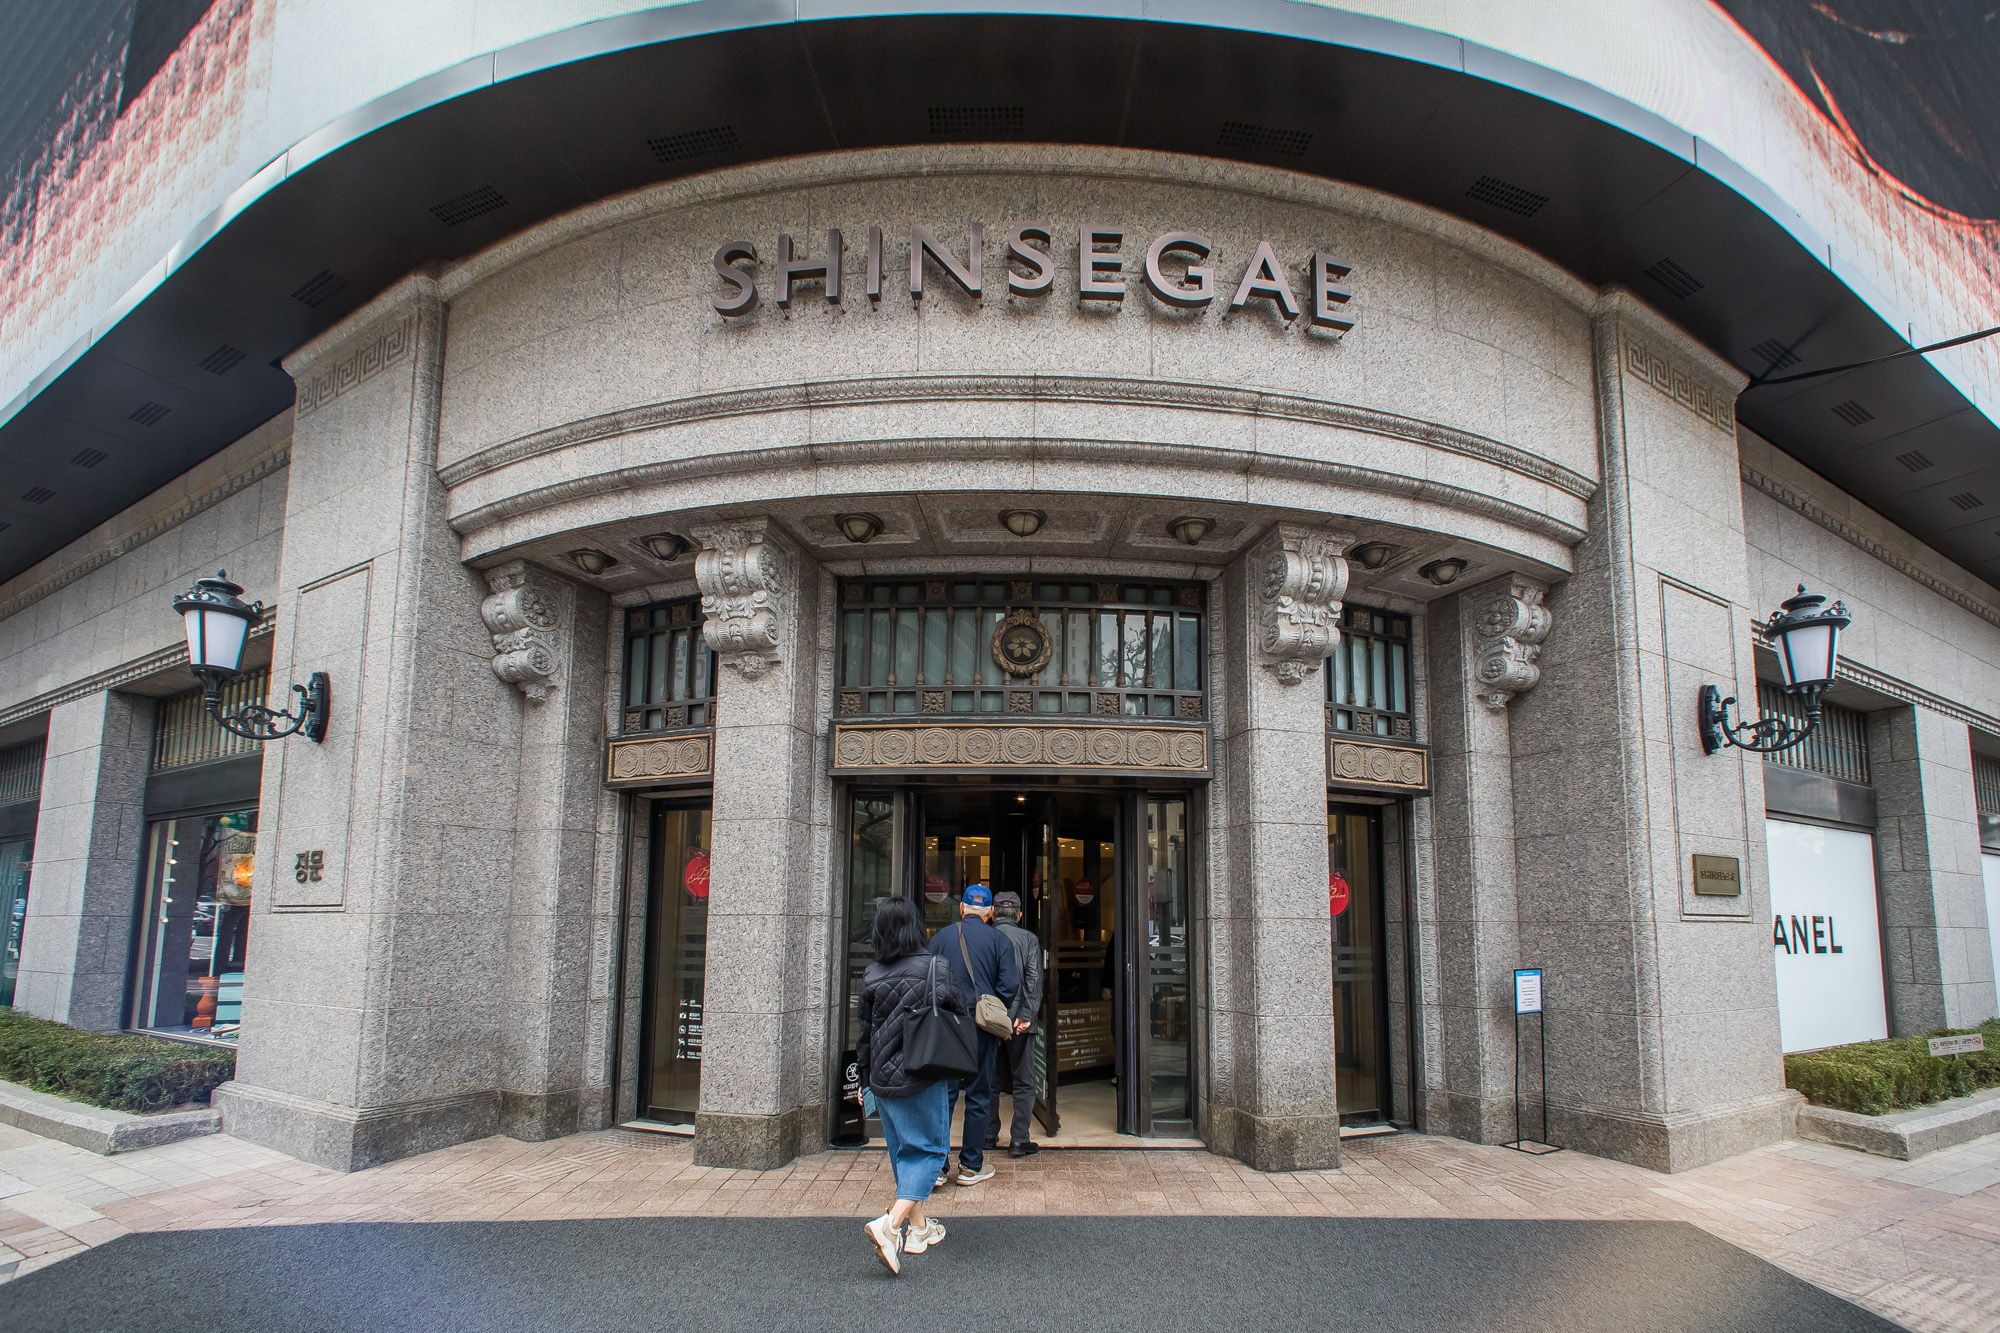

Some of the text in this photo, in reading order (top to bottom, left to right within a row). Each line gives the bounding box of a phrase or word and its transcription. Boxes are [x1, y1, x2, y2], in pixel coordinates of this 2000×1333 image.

[712, 222, 1355, 332] SHINSEGAE
[295, 850, 325, 883] 정문
[1700, 869, 1737, 881] SHINSEGAE
[1773, 914, 1843, 954] ANEL
